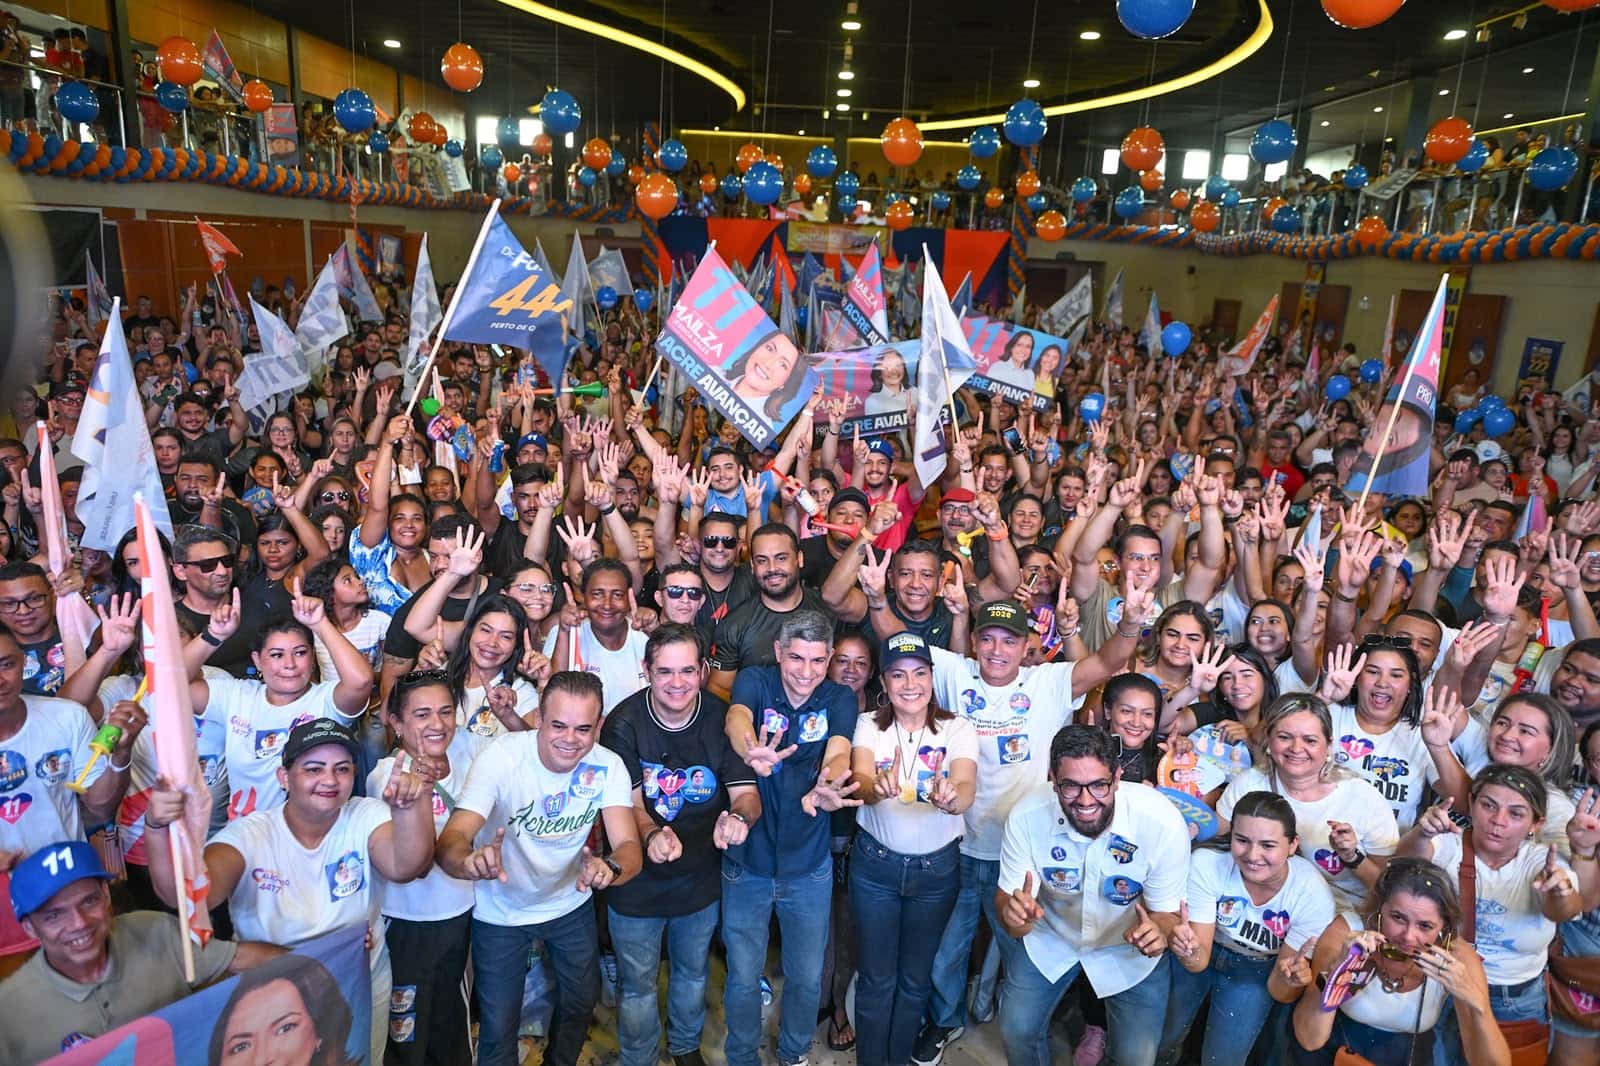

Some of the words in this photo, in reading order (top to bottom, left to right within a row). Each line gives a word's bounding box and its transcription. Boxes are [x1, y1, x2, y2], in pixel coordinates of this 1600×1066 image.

[694, 267, 756, 331] 11
[490, 322, 515, 330] PERTO
[515, 323, 527, 331] DE
[843, 302, 872, 335] ACRE
[673, 300, 724, 359] MAILZA
[968, 319, 1001, 353] 11
[823, 360, 855, 395] 11
[659, 335, 705, 380] ACRE
[697, 374, 769, 443] AVANÇAR
[870, 440, 882, 449] 11
[1349, 741, 1365, 753] 11
[665, 774, 679, 787] 11
[3, 798, 21, 814] 11
[548, 797, 561, 811] 11
[42, 846, 74, 877] 11
[1325, 856, 1340, 869] 11
[1271, 916, 1284, 931] 11
